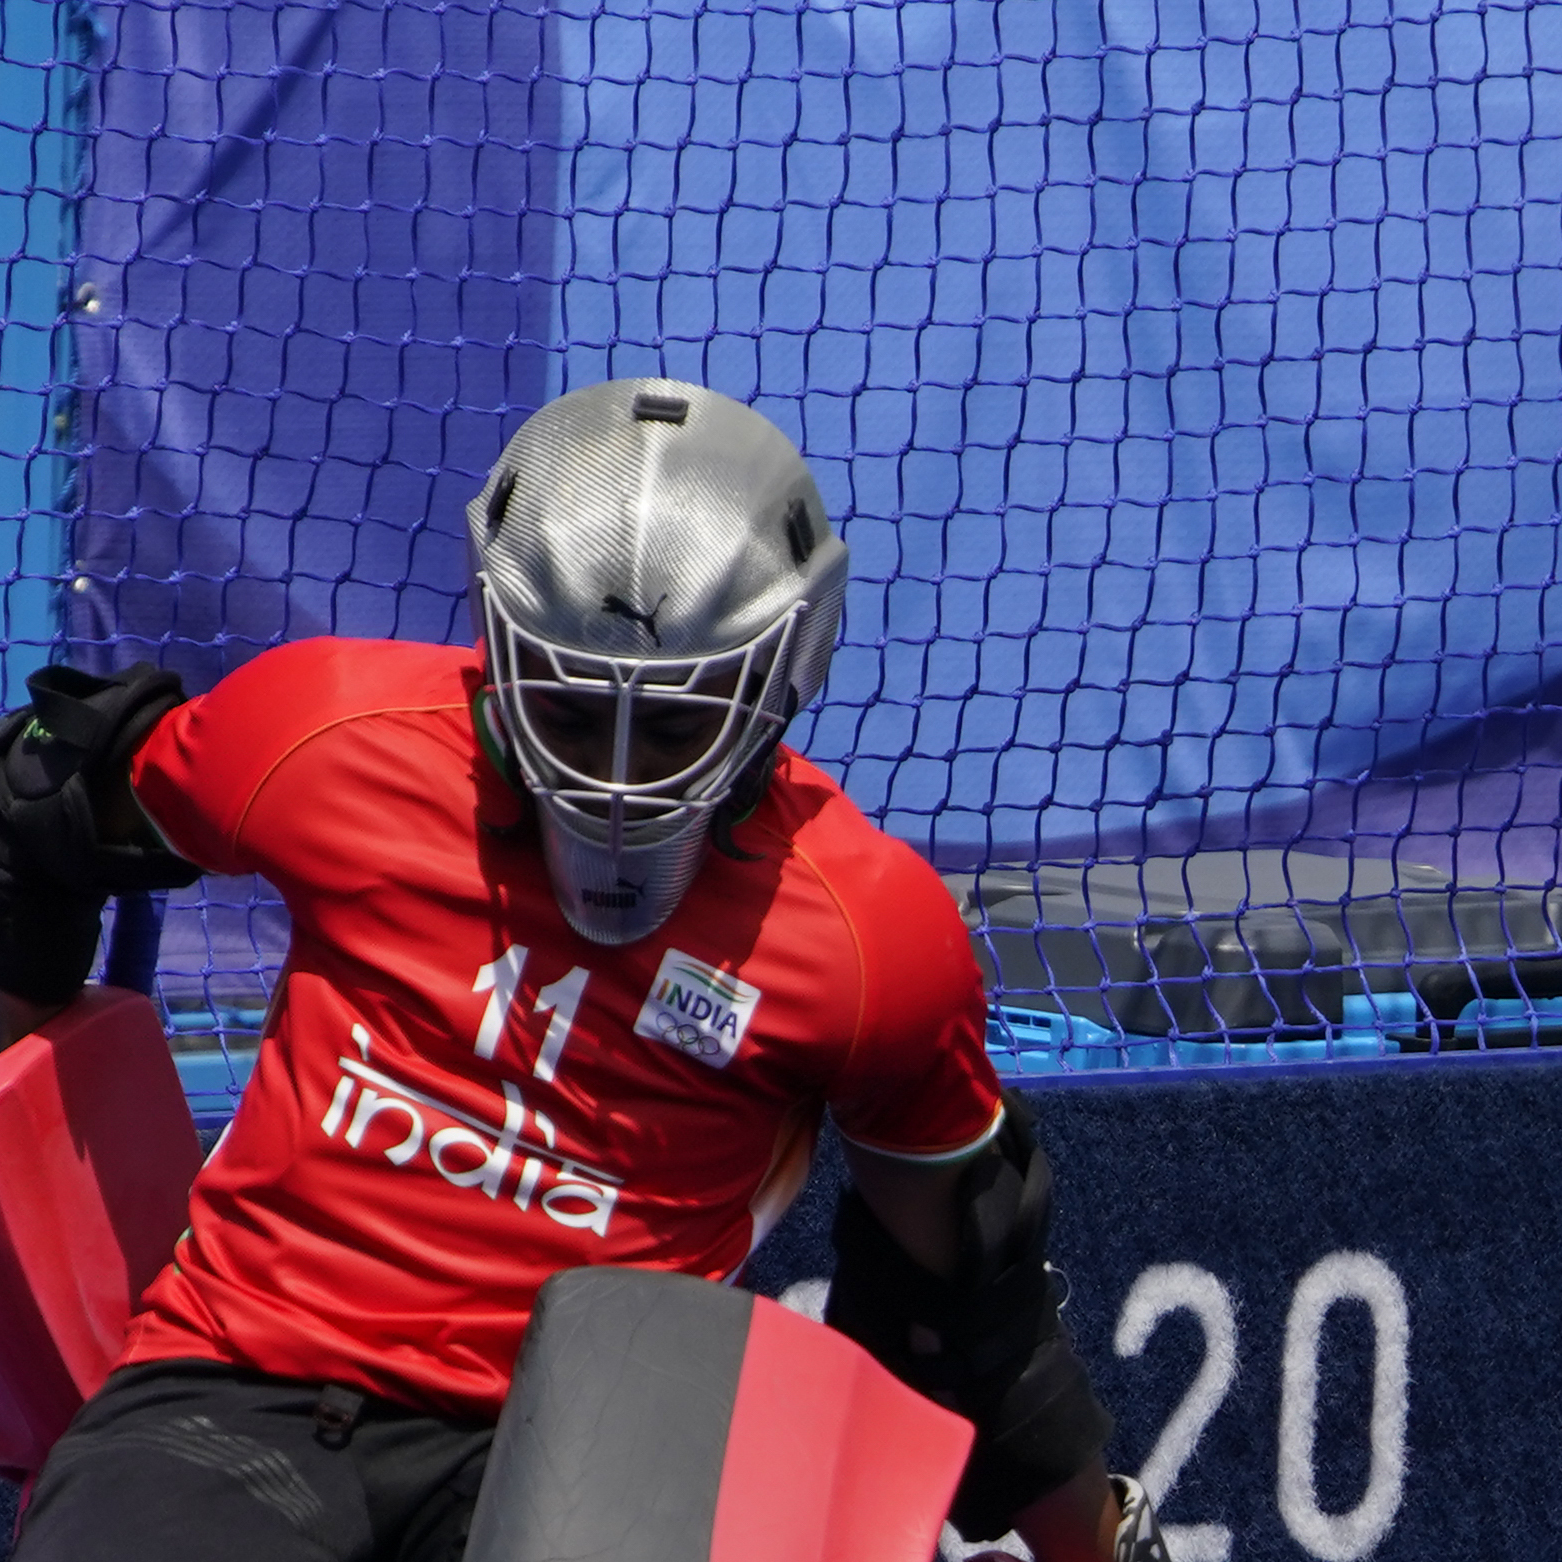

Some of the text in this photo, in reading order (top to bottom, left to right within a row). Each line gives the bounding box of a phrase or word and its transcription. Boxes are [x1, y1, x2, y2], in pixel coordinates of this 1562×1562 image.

[472, 944, 591, 1083] 11
[655, 977, 738, 1040] INDIA
[321, 1022, 625, 1238] india
